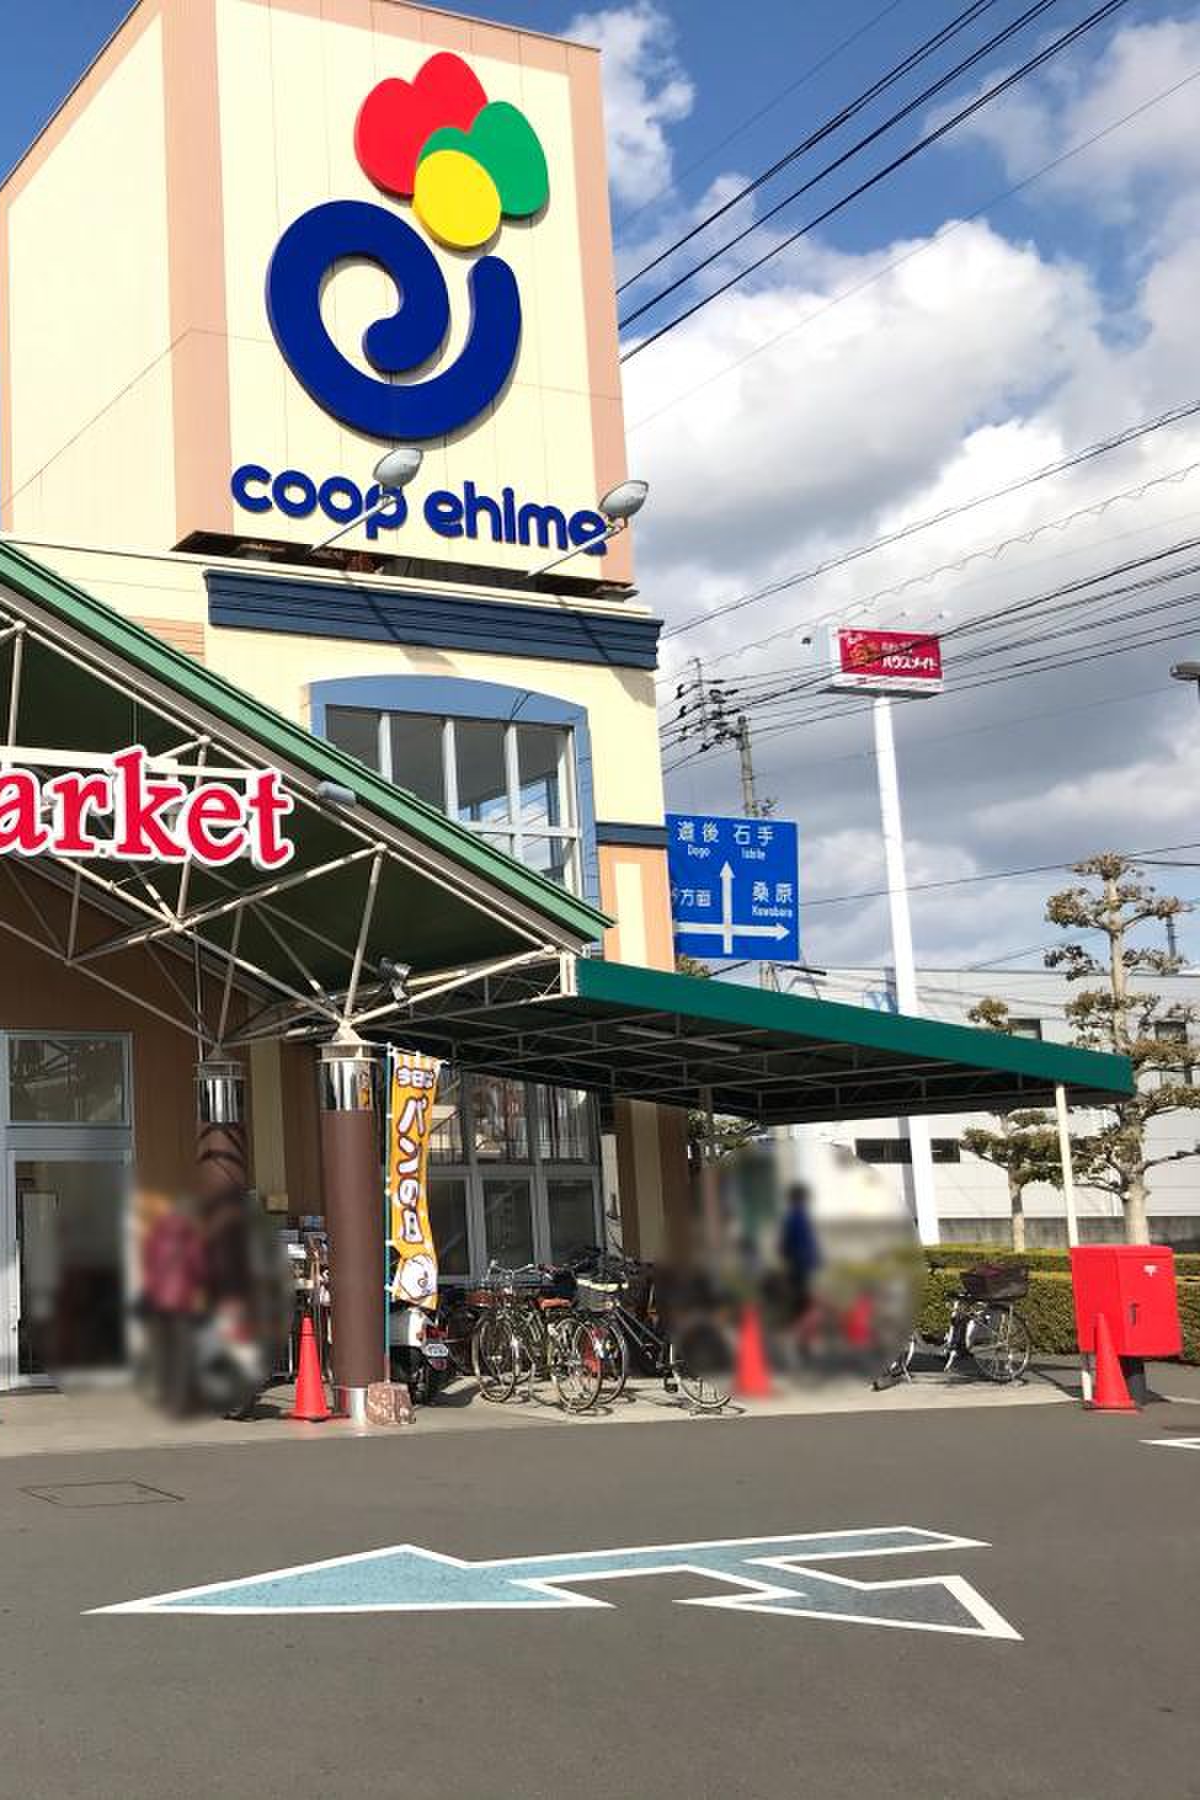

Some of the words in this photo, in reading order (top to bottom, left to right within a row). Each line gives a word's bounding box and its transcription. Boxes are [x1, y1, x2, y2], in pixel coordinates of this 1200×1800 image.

[231, 464, 407, 539] coop
[424, 481, 608, 555] ehime
[677, 821, 719, 843] 道後
[733, 823, 774, 846] 石手
